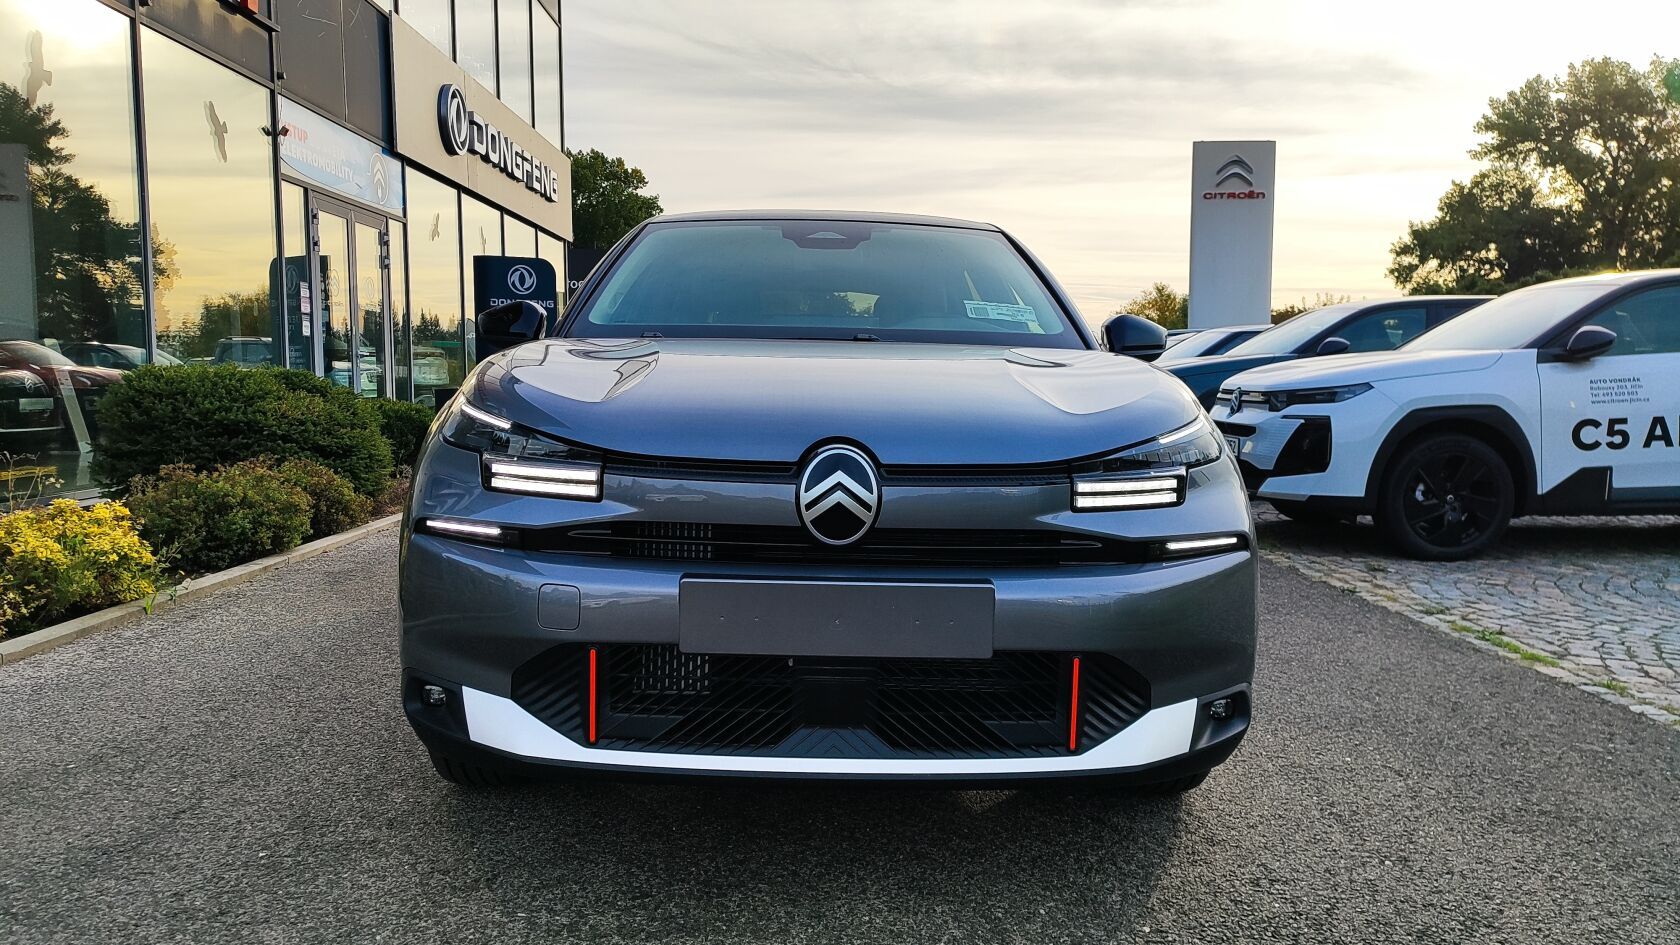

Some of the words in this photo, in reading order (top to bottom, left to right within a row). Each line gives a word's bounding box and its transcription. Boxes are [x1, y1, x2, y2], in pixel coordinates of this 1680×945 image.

[281, 143, 354, 182] ELEKTROMOBILITY
[468, 111, 558, 203] DONGFENG
[1571, 417, 1630, 451] C5
[1642, 416, 1680, 449] A
